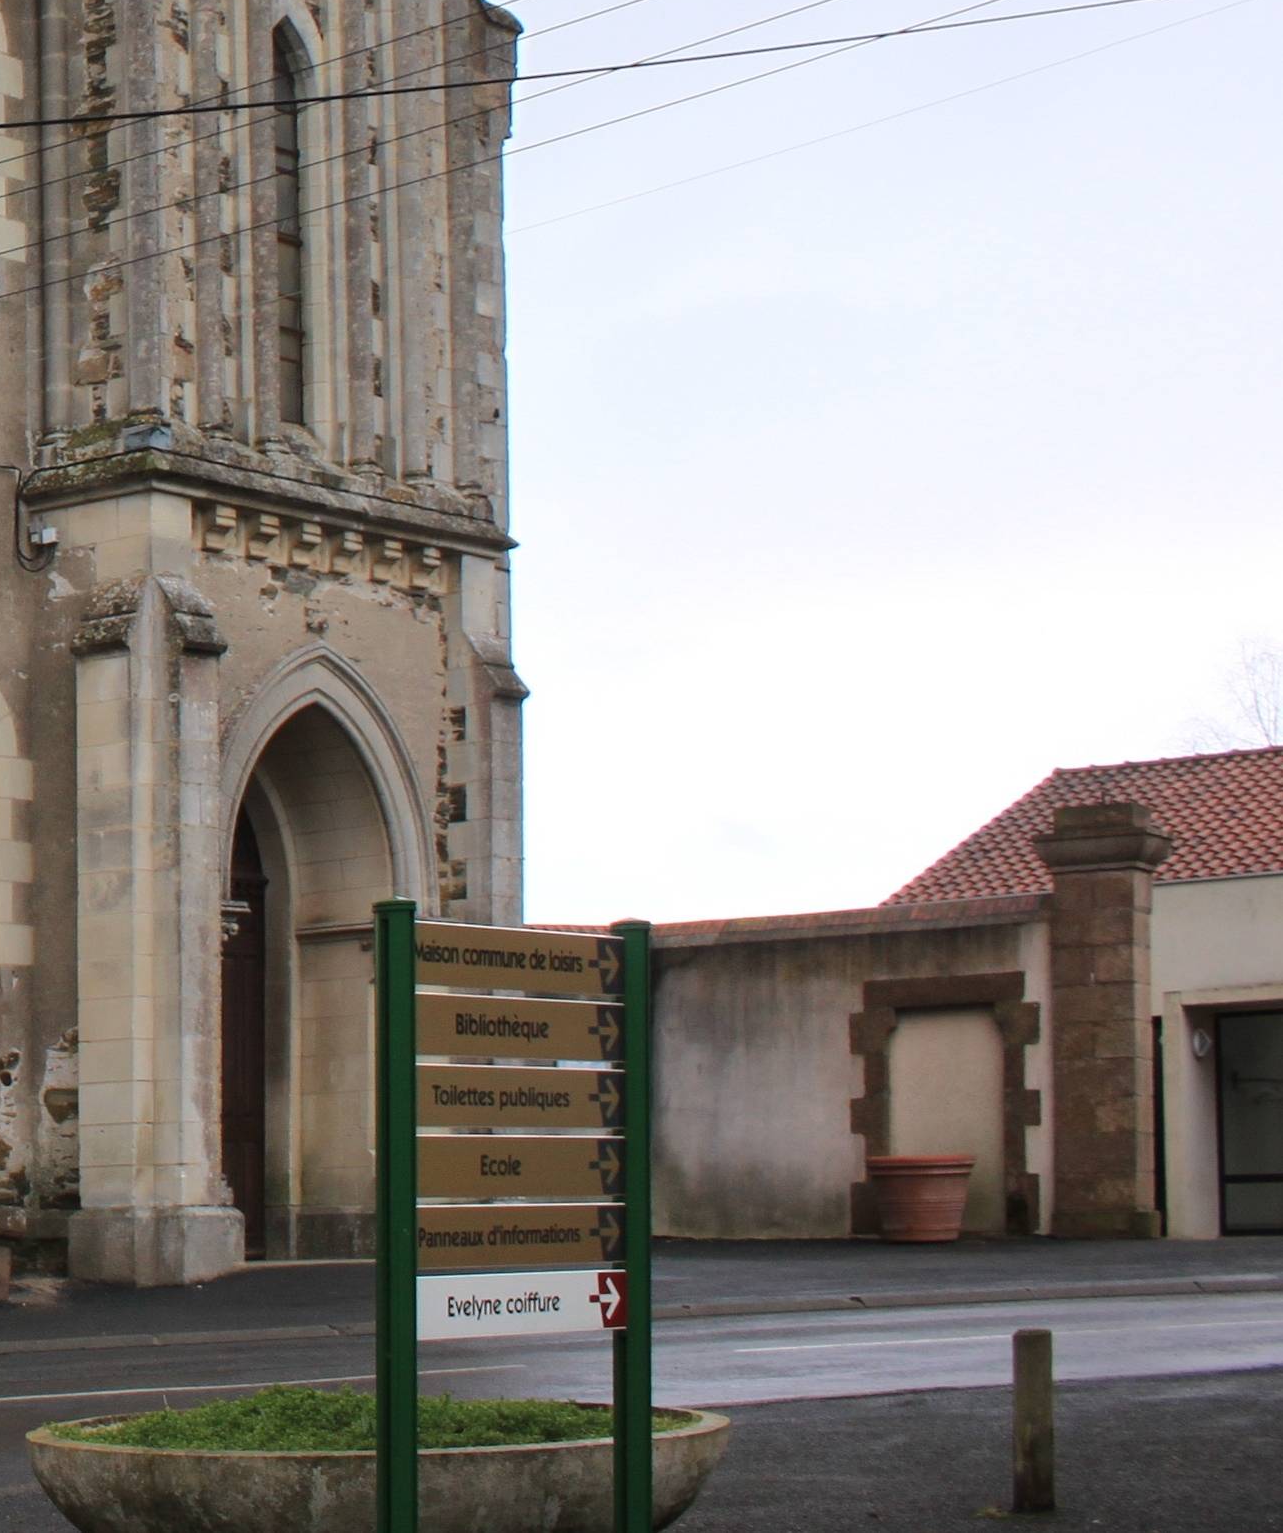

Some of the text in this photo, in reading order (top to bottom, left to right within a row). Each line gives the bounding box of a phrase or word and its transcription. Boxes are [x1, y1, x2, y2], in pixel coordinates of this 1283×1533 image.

[414, 940, 583, 973] Maison commune de loisirs
[455, 1013, 550, 1042] Bibliothèque
[432, 1085, 570, 1111] Toilettes publiques
[480, 1155, 522, 1176] Ecole
[418, 1224, 581, 1248] Panneaux d'informations
[447, 1292, 560, 1320] Evelyne coiffure
